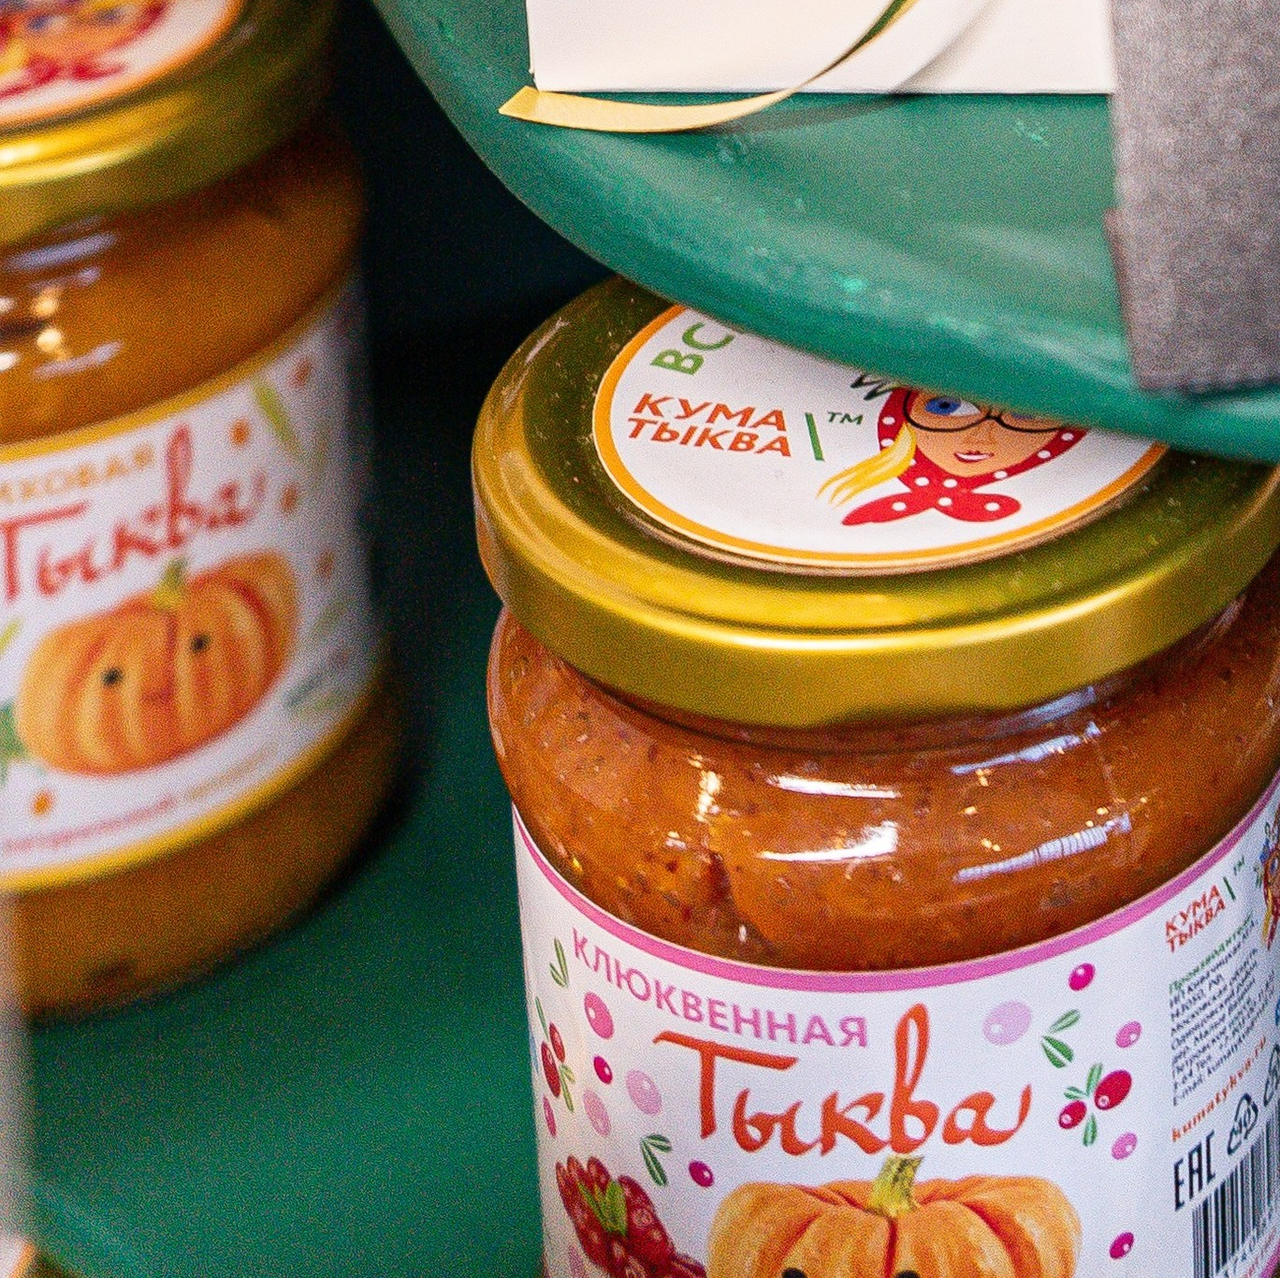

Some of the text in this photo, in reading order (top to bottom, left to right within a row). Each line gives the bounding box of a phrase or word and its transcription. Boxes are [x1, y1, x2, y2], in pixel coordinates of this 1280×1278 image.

[626, 417, 793, 458] ТЫКВА
[631, 391, 789, 433] КУМА
[1165, 885, 1221, 938] КУМА
[1167, 898, 1226, 954] ТЫКВА
[573, 927, 868, 1048] КЛЮКВЕННАЯ
[652, 1002, 1032, 1158] Тыква
[1171, 1035, 1266, 1144] kumatykva.ru
